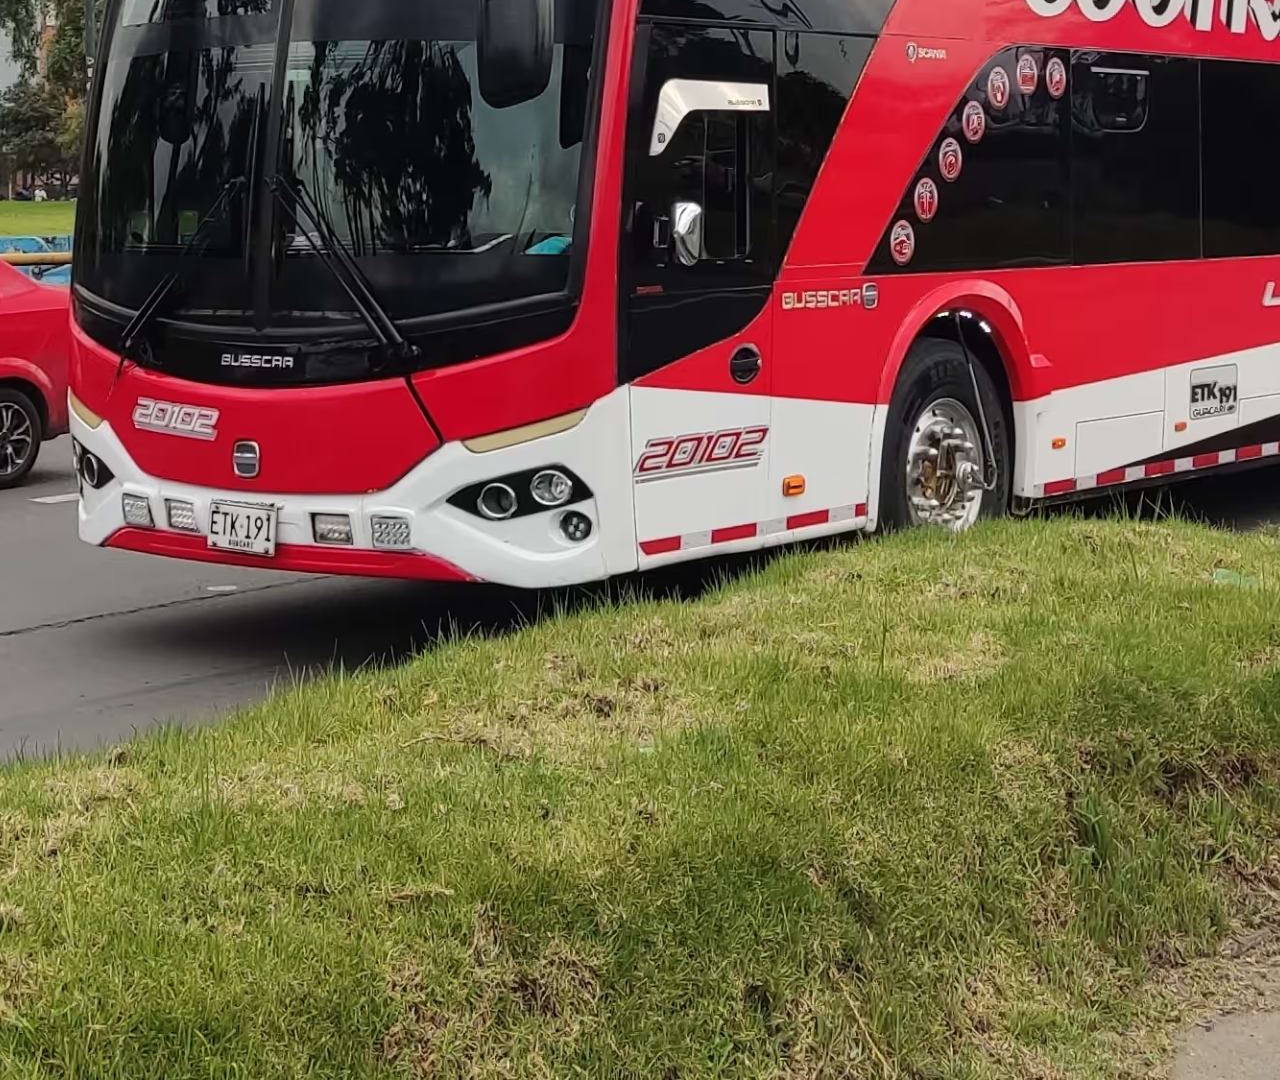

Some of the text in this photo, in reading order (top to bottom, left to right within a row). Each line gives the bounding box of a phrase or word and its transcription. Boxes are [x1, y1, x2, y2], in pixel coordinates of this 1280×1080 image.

[782, 288, 861, 310] BUSSCAR
[221, 353, 295, 368] BUSSCAR
[1191, 381, 1237, 404] ETK 191
[133, 396, 220, 434] 20102
[634, 425, 769, 474] 20102
